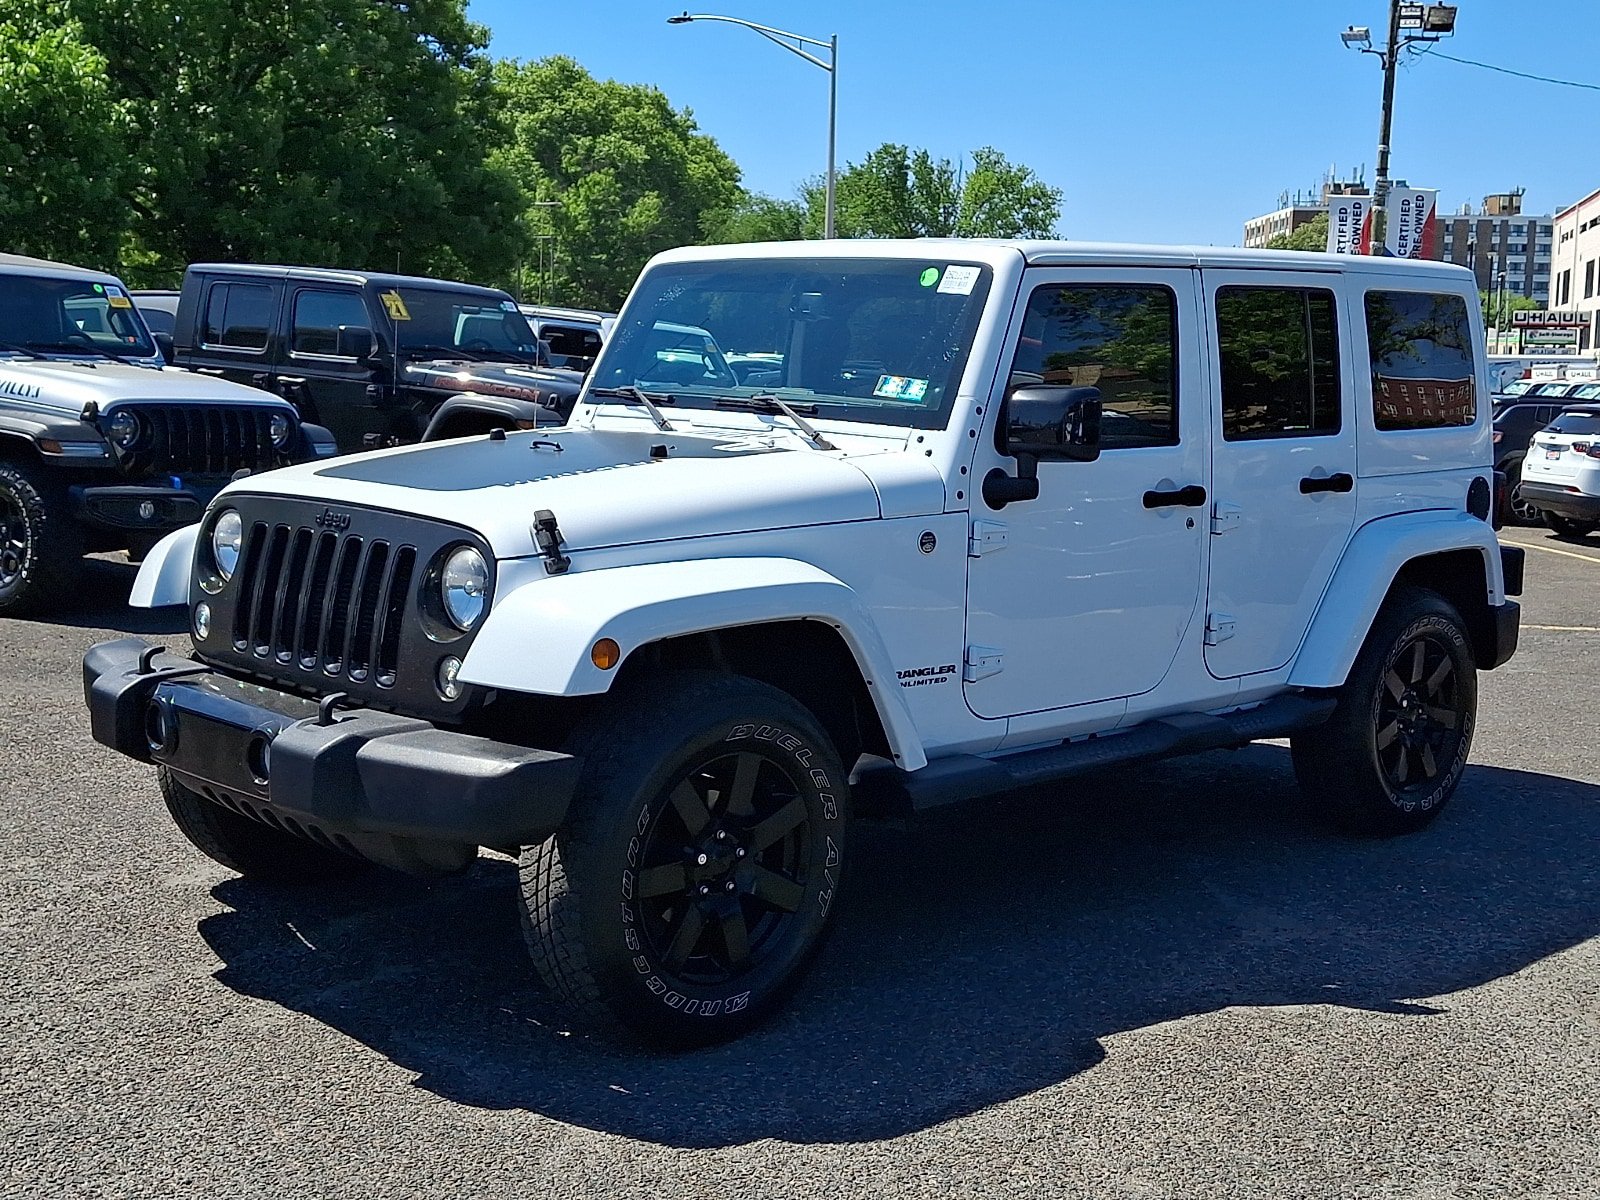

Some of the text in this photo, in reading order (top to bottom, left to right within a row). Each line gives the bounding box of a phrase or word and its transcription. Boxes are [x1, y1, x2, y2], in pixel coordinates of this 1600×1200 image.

[1337, 207, 1348, 254] RTIFIED
[1350, 201, 1362, 256] E-OWNED
[1398, 199, 1411, 256] CERTIFIED
[1412, 194, 1425, 259] PRE-OWNED
[315, 506, 351, 533] Jeep
[896, 664, 957, 679] RANGLER
[900, 676, 948, 688] NLIMITED
[725, 723, 839, 917] DUELER A/T
[621, 803, 751, 1016] BRIDGESTONE
